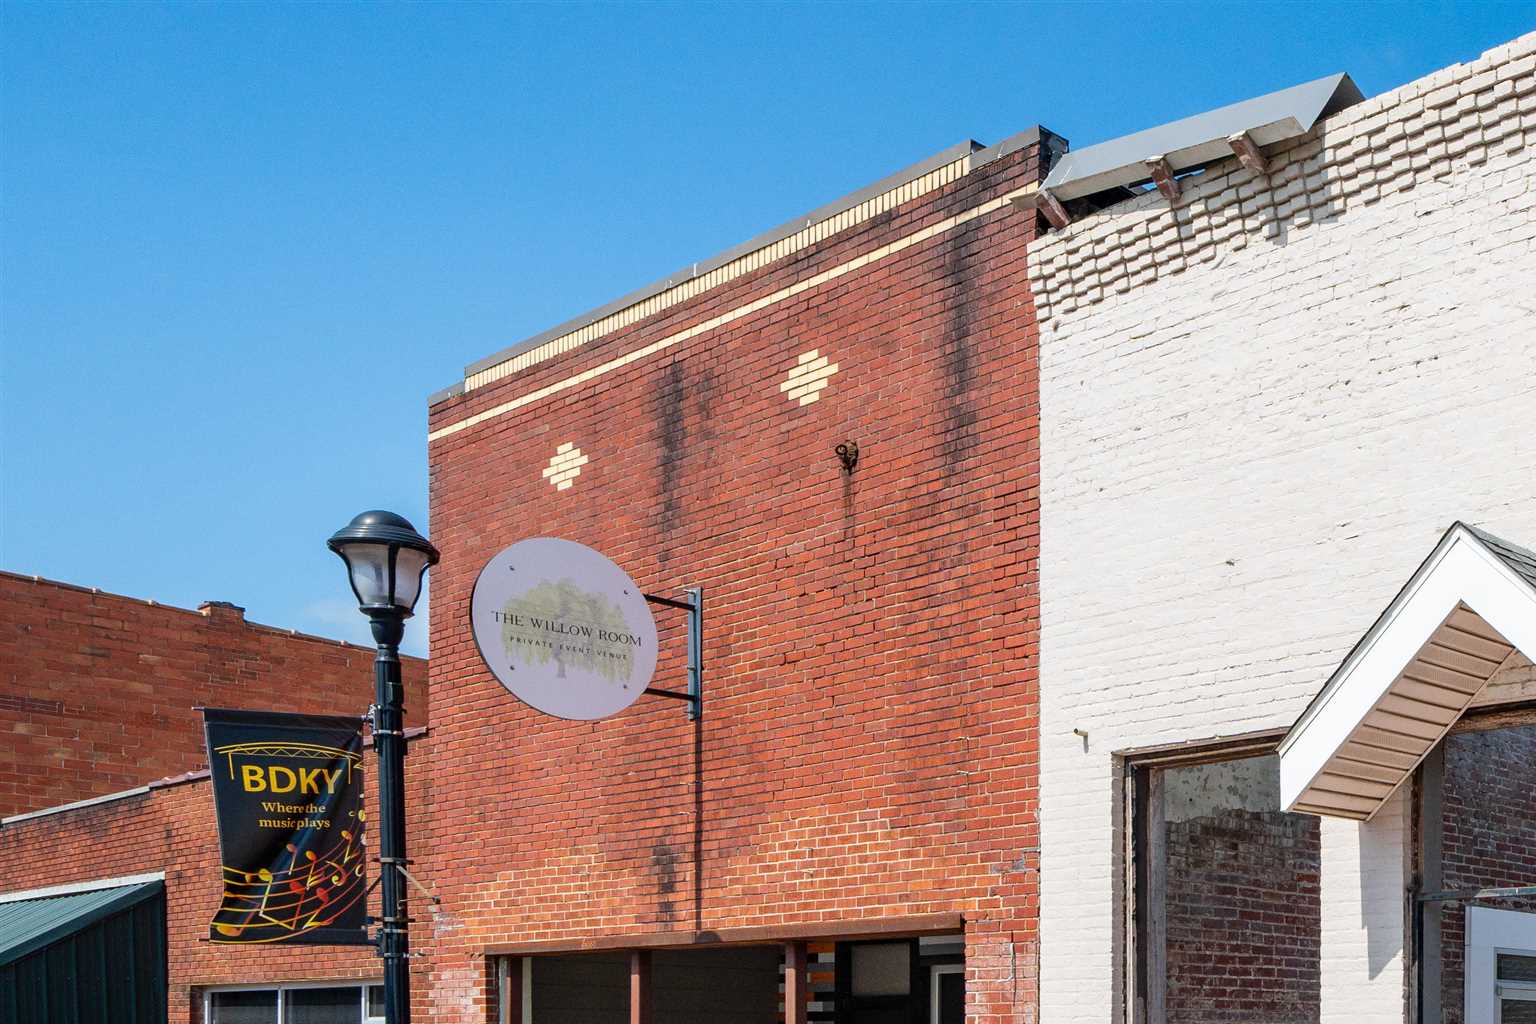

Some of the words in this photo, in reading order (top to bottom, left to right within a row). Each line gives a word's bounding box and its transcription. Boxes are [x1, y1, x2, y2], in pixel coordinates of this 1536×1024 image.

[491, 610, 525, 627] THE
[531, 617, 594, 638] WILLOW
[599, 629, 642, 647] ROOM
[510, 636, 553, 649] PRIVATE
[559, 644, 591, 654] EVENT
[597, 650, 628, 660] VENUE
[241, 765, 343, 794] BDKY
[261, 802, 305, 813] Where
[305, 803, 327, 813] the
[259, 818, 297, 829] music
[296, 818, 331, 831] plays
